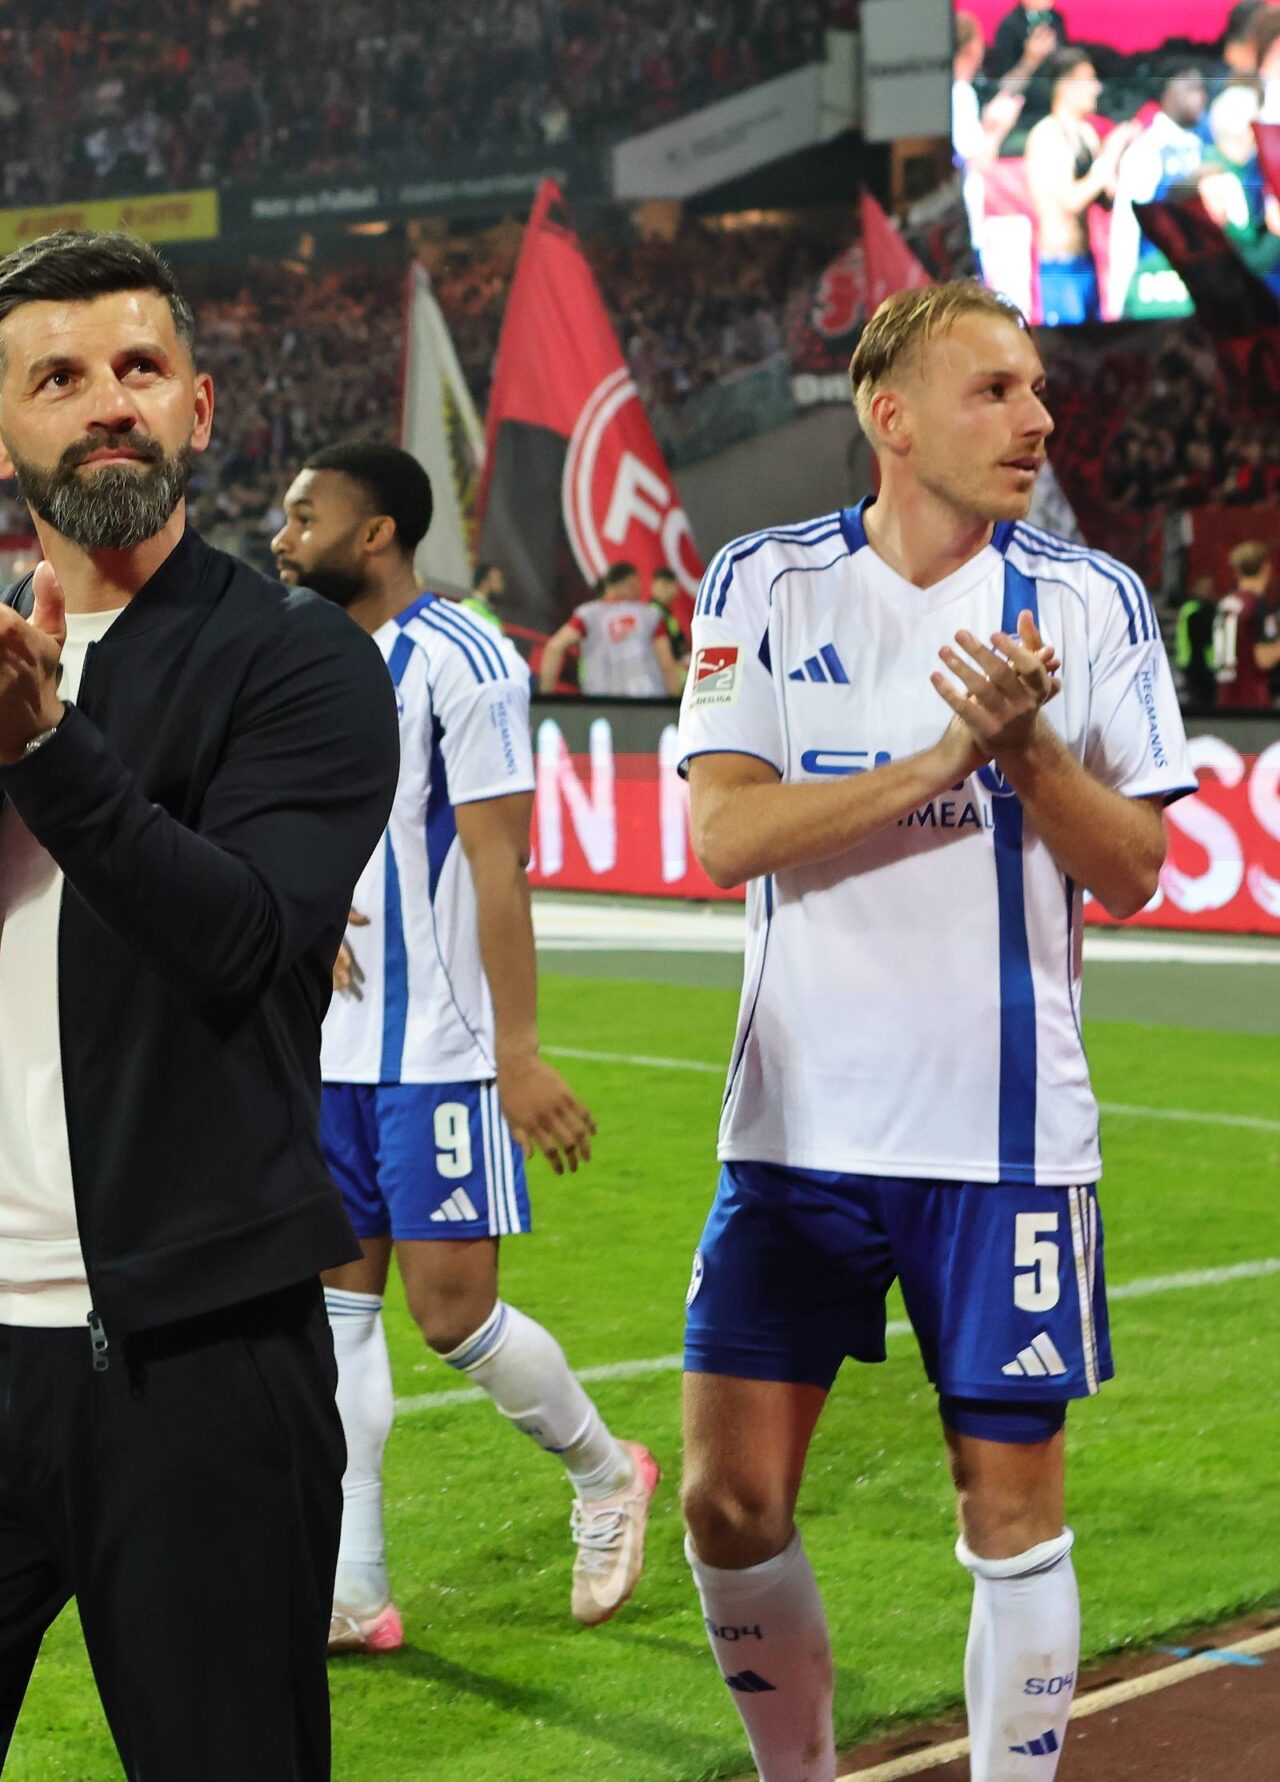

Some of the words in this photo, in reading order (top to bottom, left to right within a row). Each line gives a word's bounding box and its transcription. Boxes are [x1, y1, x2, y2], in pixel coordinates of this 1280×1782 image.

[1141, 671, 1168, 768] HEGMANNS
[433, 1102, 473, 1179] 9
[1014, 1212, 1060, 1312] 5
